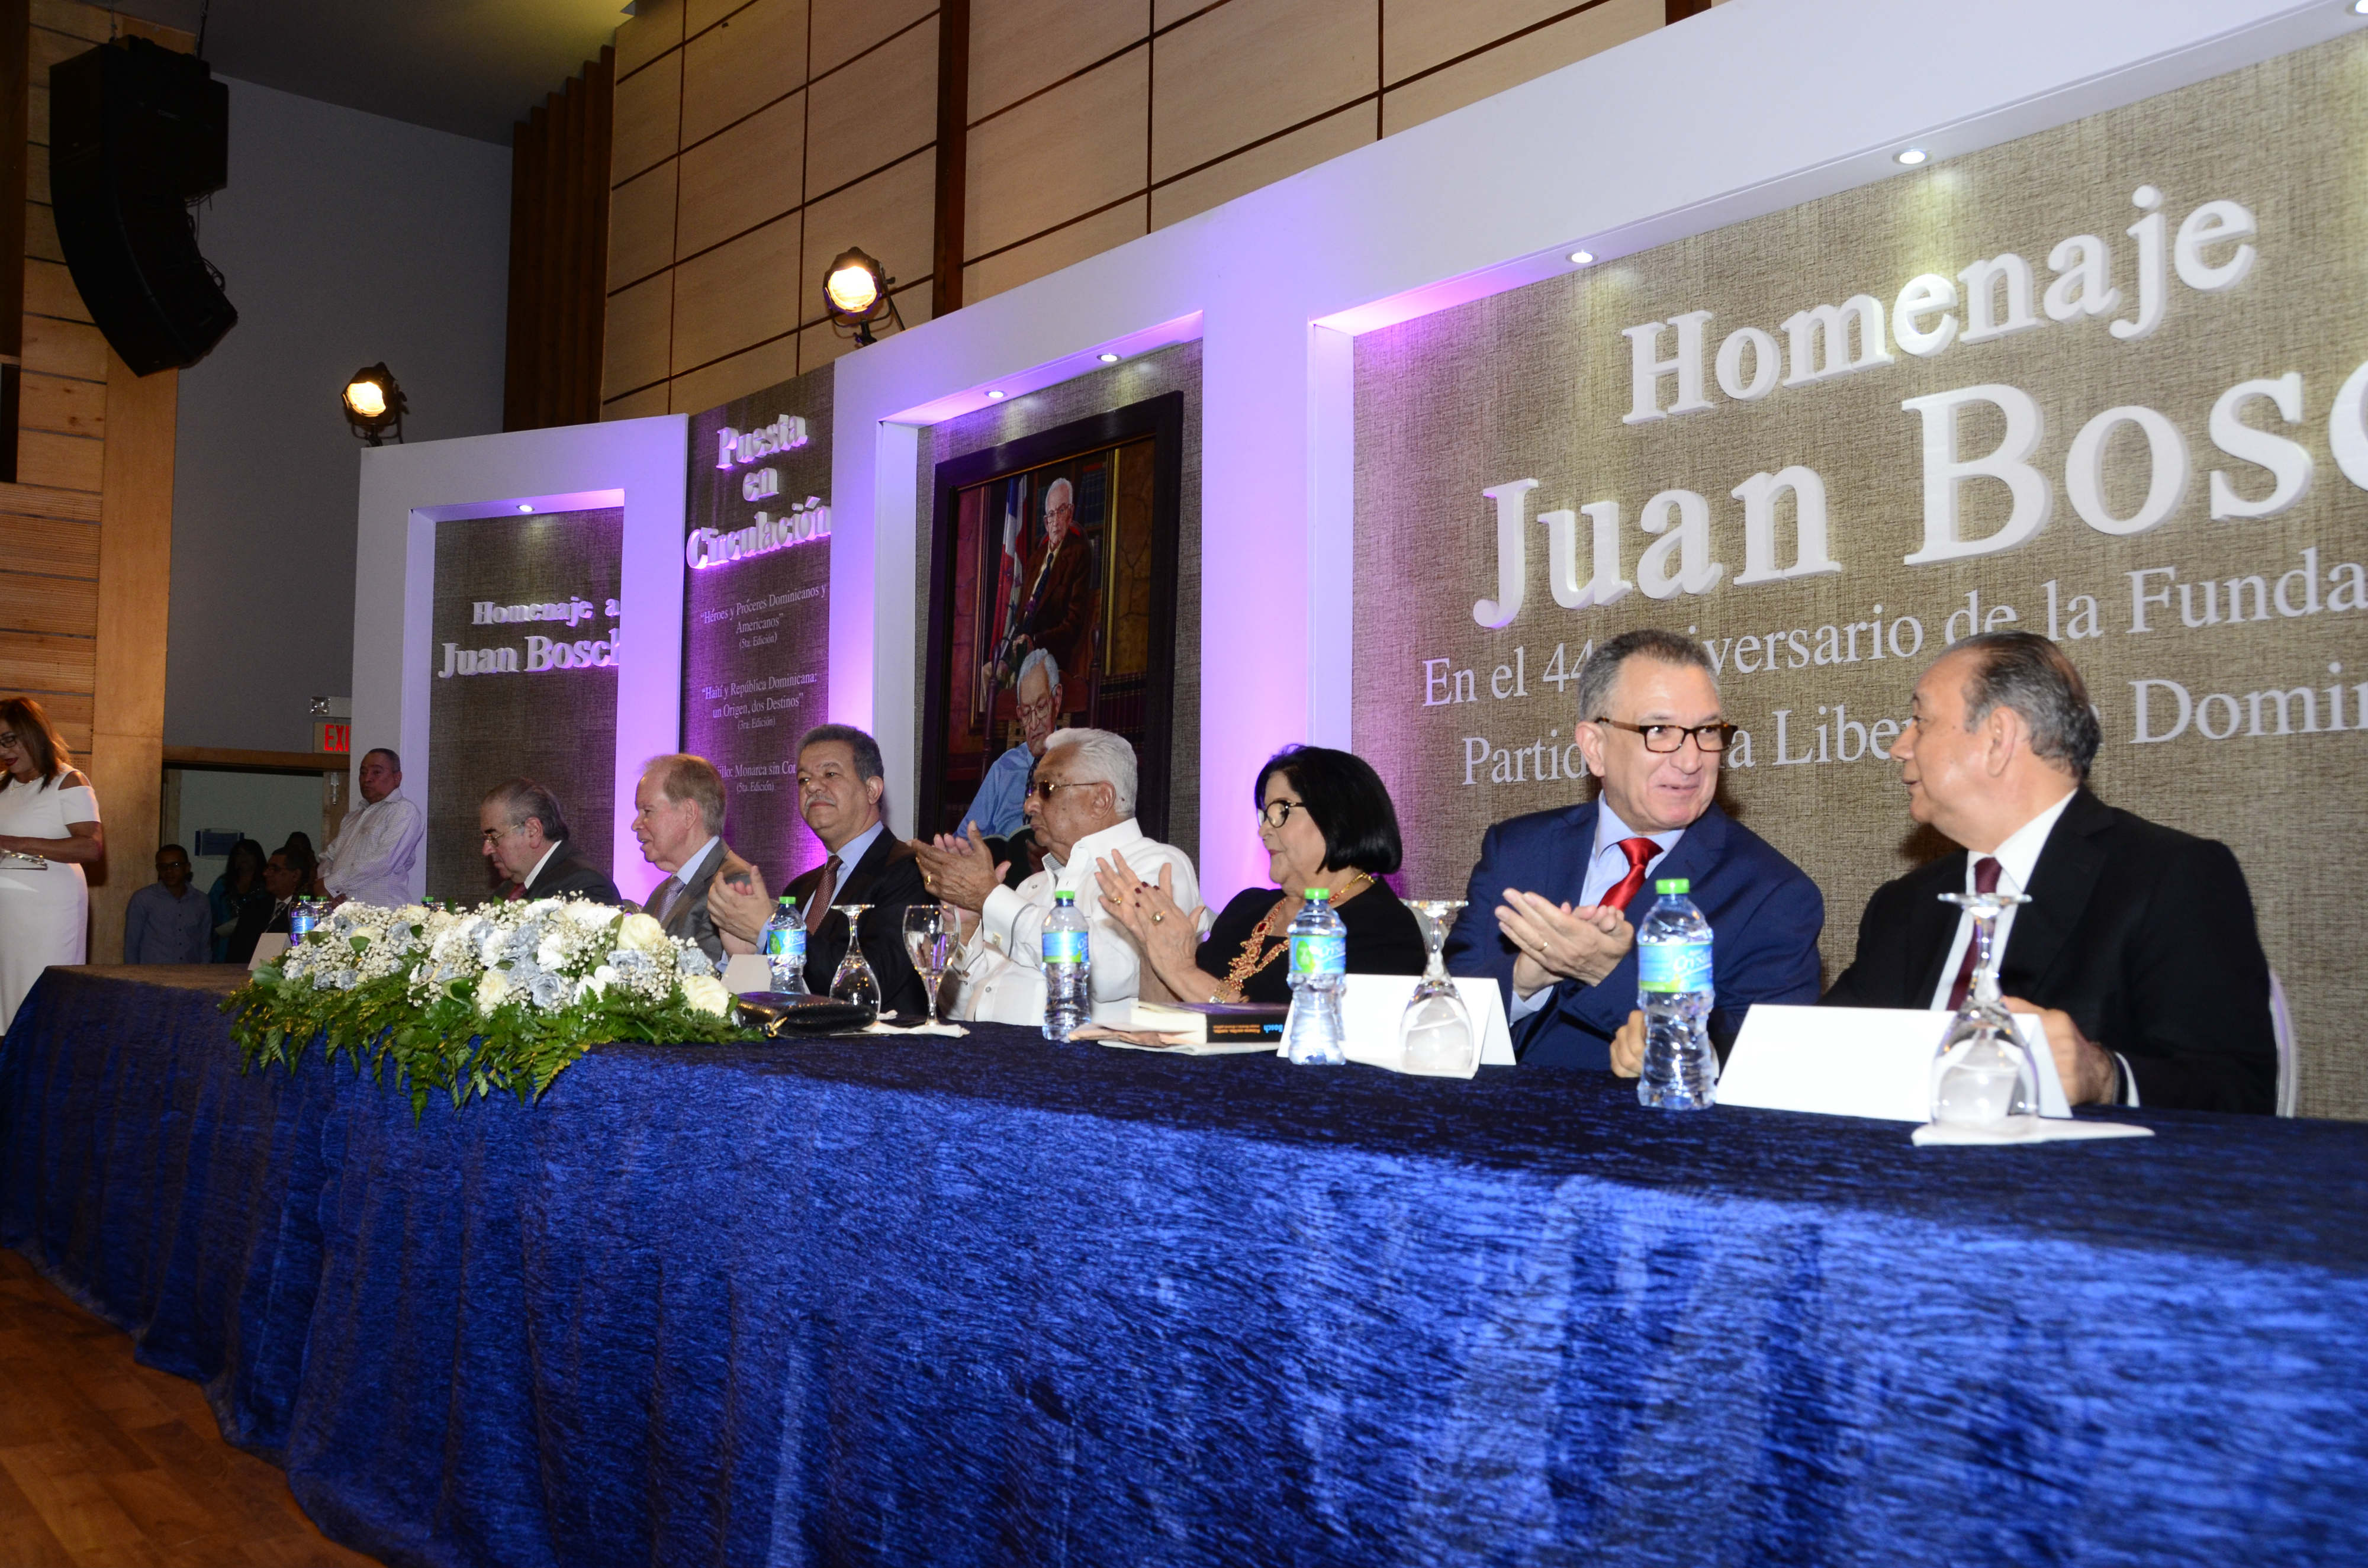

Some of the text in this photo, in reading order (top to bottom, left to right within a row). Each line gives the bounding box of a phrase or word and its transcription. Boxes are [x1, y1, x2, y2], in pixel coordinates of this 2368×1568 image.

[1621, 184, 2257, 426] Homenaje
[716, 414, 809, 469] Puesta
[742, 467, 779, 501] en
[686, 495, 831, 569] Circulación
[1472, 465, 1841, 627] Juan
[471, 596, 620, 627] Homenaje a
[729, 607, 735, 621] y
[736, 598, 767, 616] Próceres
[769, 588, 819, 607] Dominicanos
[818, 584, 826, 598] y
[438, 642, 519, 678] Juan
[1423, 657, 1475, 707] En
[1491, 646, 1527, 699] el
[1688, 604, 1923, 677] versario
[1945, 590, 2018, 645] de
[2041, 579, 2104, 642] la
[723, 688, 729, 700] y
[731, 680, 766, 697] República
[769, 672, 818, 689] Dominicana:
[713, 707, 722, 719] un
[723, 703, 750, 719] Origen,
[751, 699, 764, 713] dos
[324, 724, 351, 752] EXI
[735, 764, 767, 778] Monarca
[768, 761, 780, 775] sin
[1462, 729, 1590, 785] Partid
